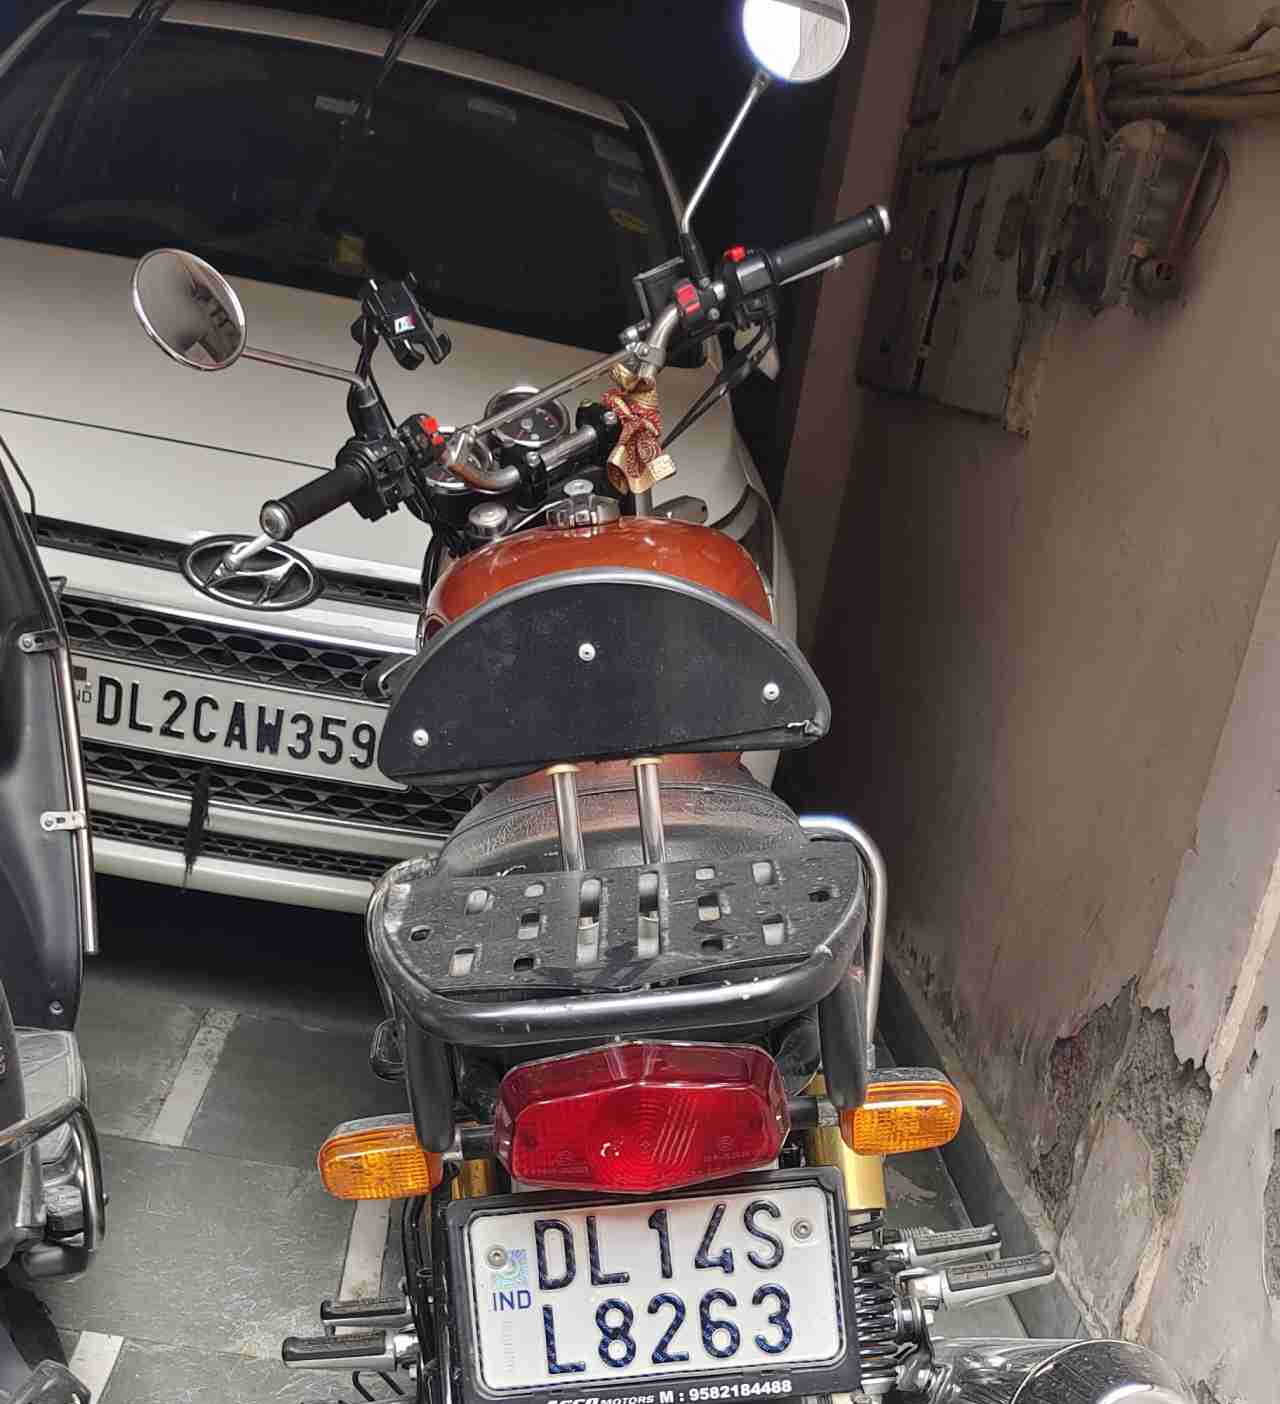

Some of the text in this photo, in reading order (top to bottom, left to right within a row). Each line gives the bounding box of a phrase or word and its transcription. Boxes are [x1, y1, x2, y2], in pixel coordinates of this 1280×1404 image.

[97, 674, 377, 769] DL2CAW359
[492, 1289, 532, 1312] IND
[542, 1283, 793, 1375] L8263
[659, 1390, 674, 1404] M
[689, 1379, 793, 1402] 9582184488
